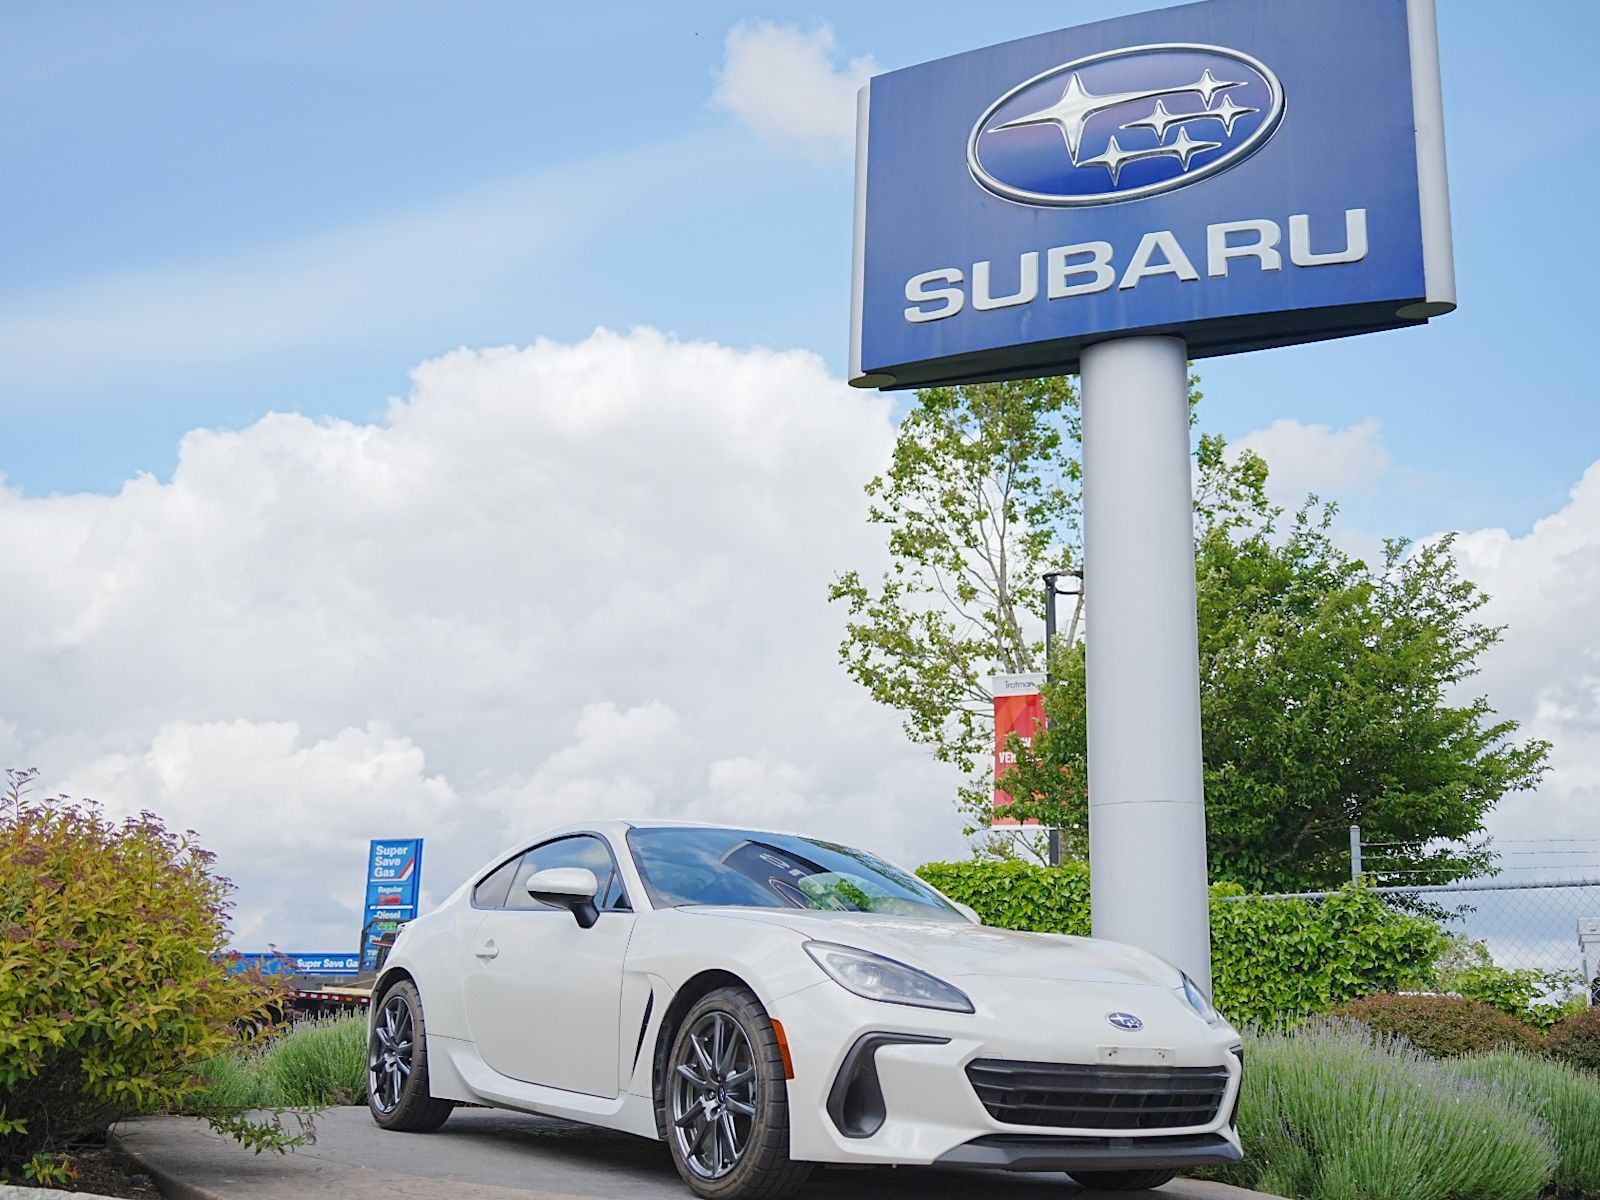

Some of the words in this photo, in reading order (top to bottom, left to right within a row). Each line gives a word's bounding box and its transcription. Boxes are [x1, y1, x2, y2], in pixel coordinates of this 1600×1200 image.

[904, 208, 1368, 323] SUBARU
[376, 845, 408, 857] Super
[375, 856, 401, 866] Save
[374, 867, 395, 877] Gas
[378, 886, 402, 894] Regular
[297, 959, 321, 970] Super
[323, 959, 344, 968] Save
[346, 959, 359, 968] Ga
